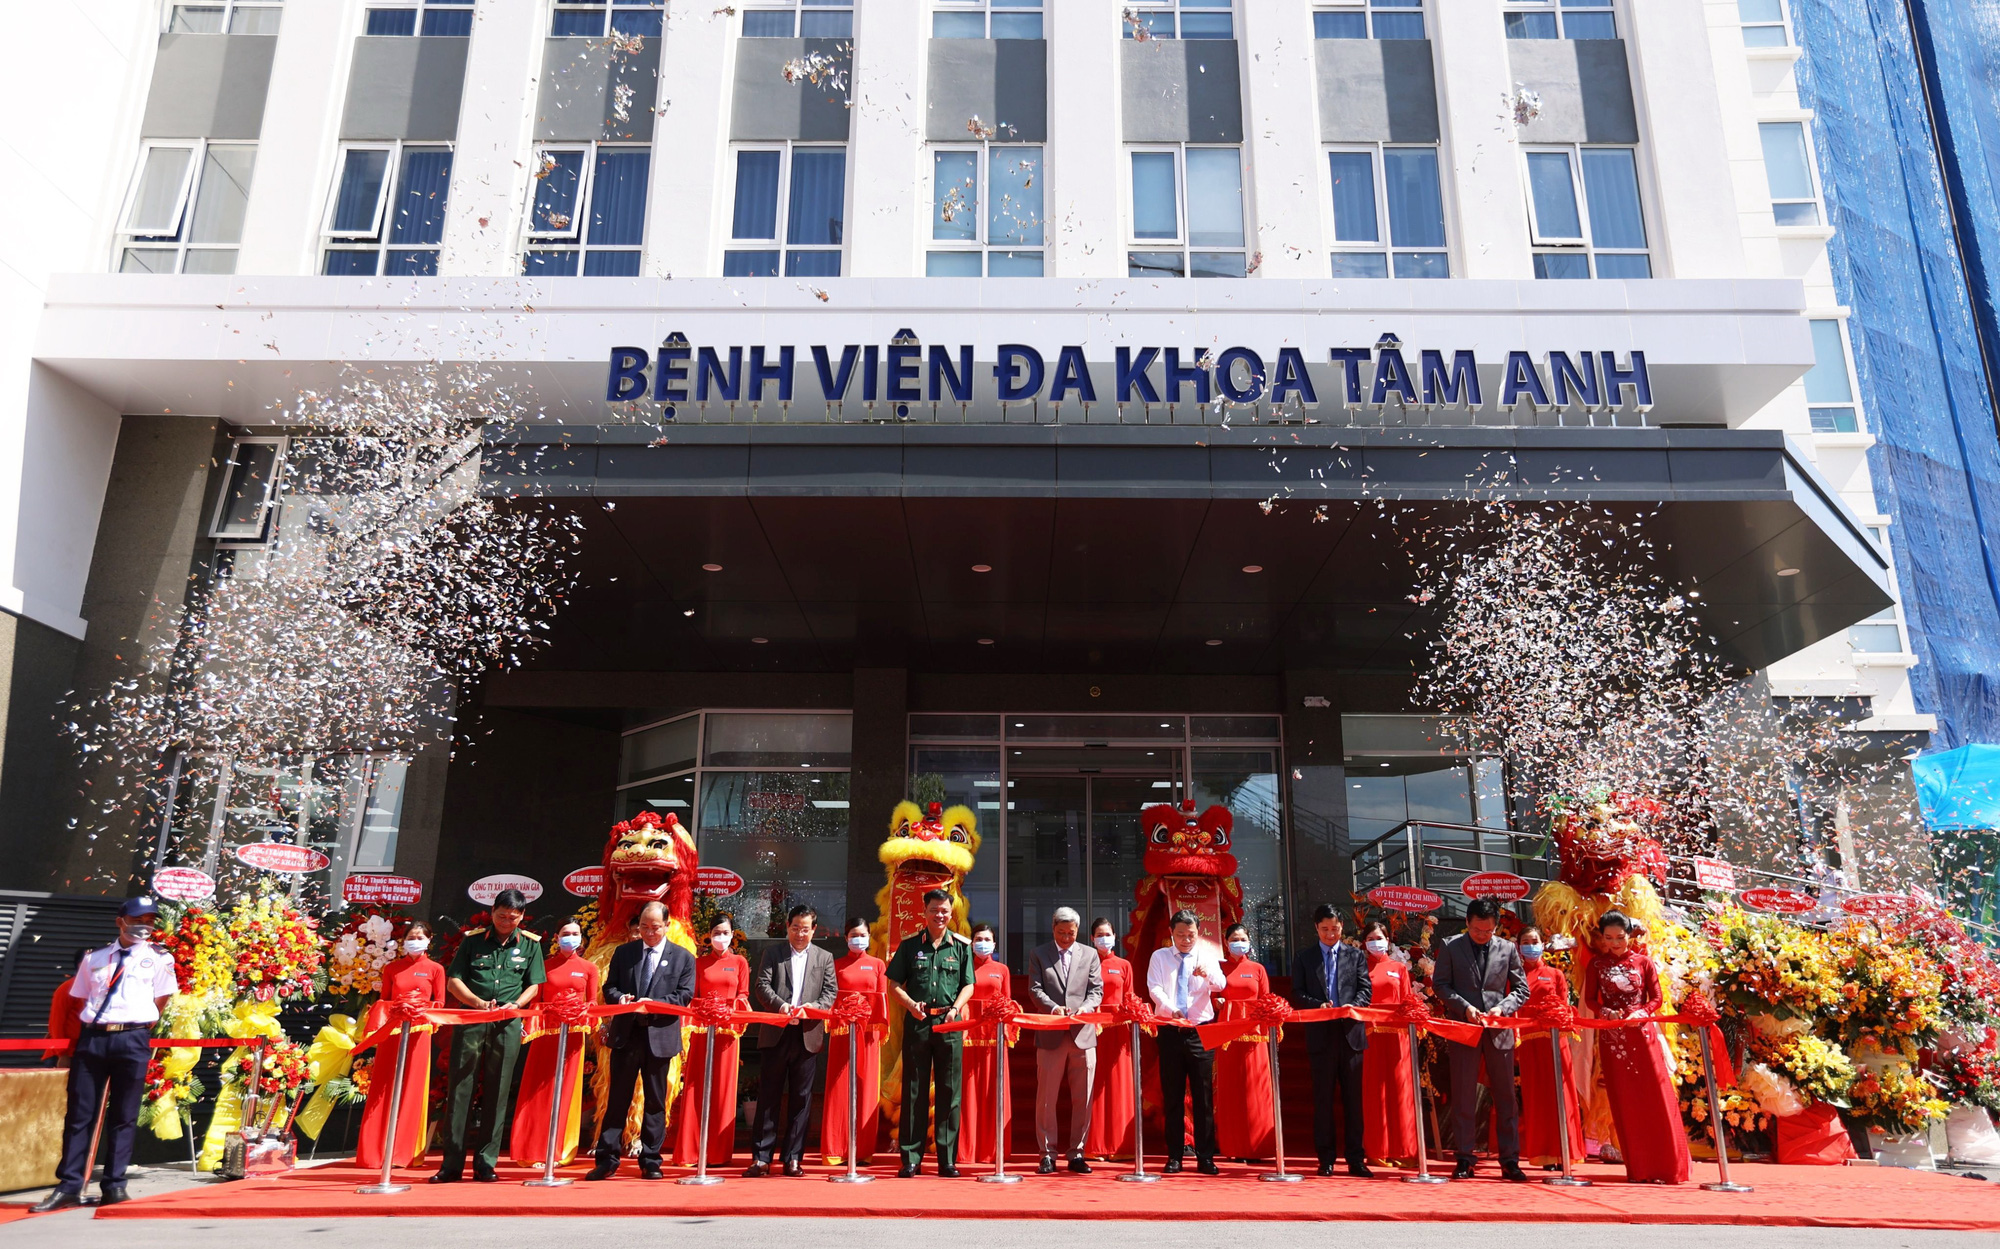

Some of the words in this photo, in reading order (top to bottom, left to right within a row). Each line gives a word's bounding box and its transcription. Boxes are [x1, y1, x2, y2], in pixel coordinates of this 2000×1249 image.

[604, 331, 797, 421] BỆNH
[810, 328, 975, 420] VIỆN
[992, 343, 1098, 407] ĐA
[1113, 345, 1320, 408] KHOA
[1327, 332, 1484, 411] TÂM
[1498, 350, 1655, 413] ANH
[472, 882, 486, 890] CÔNG
[494, 881, 503, 890] XÂY
[576, 884, 595, 893] CHÚC
[1423, 894, 1438, 902] MINH
